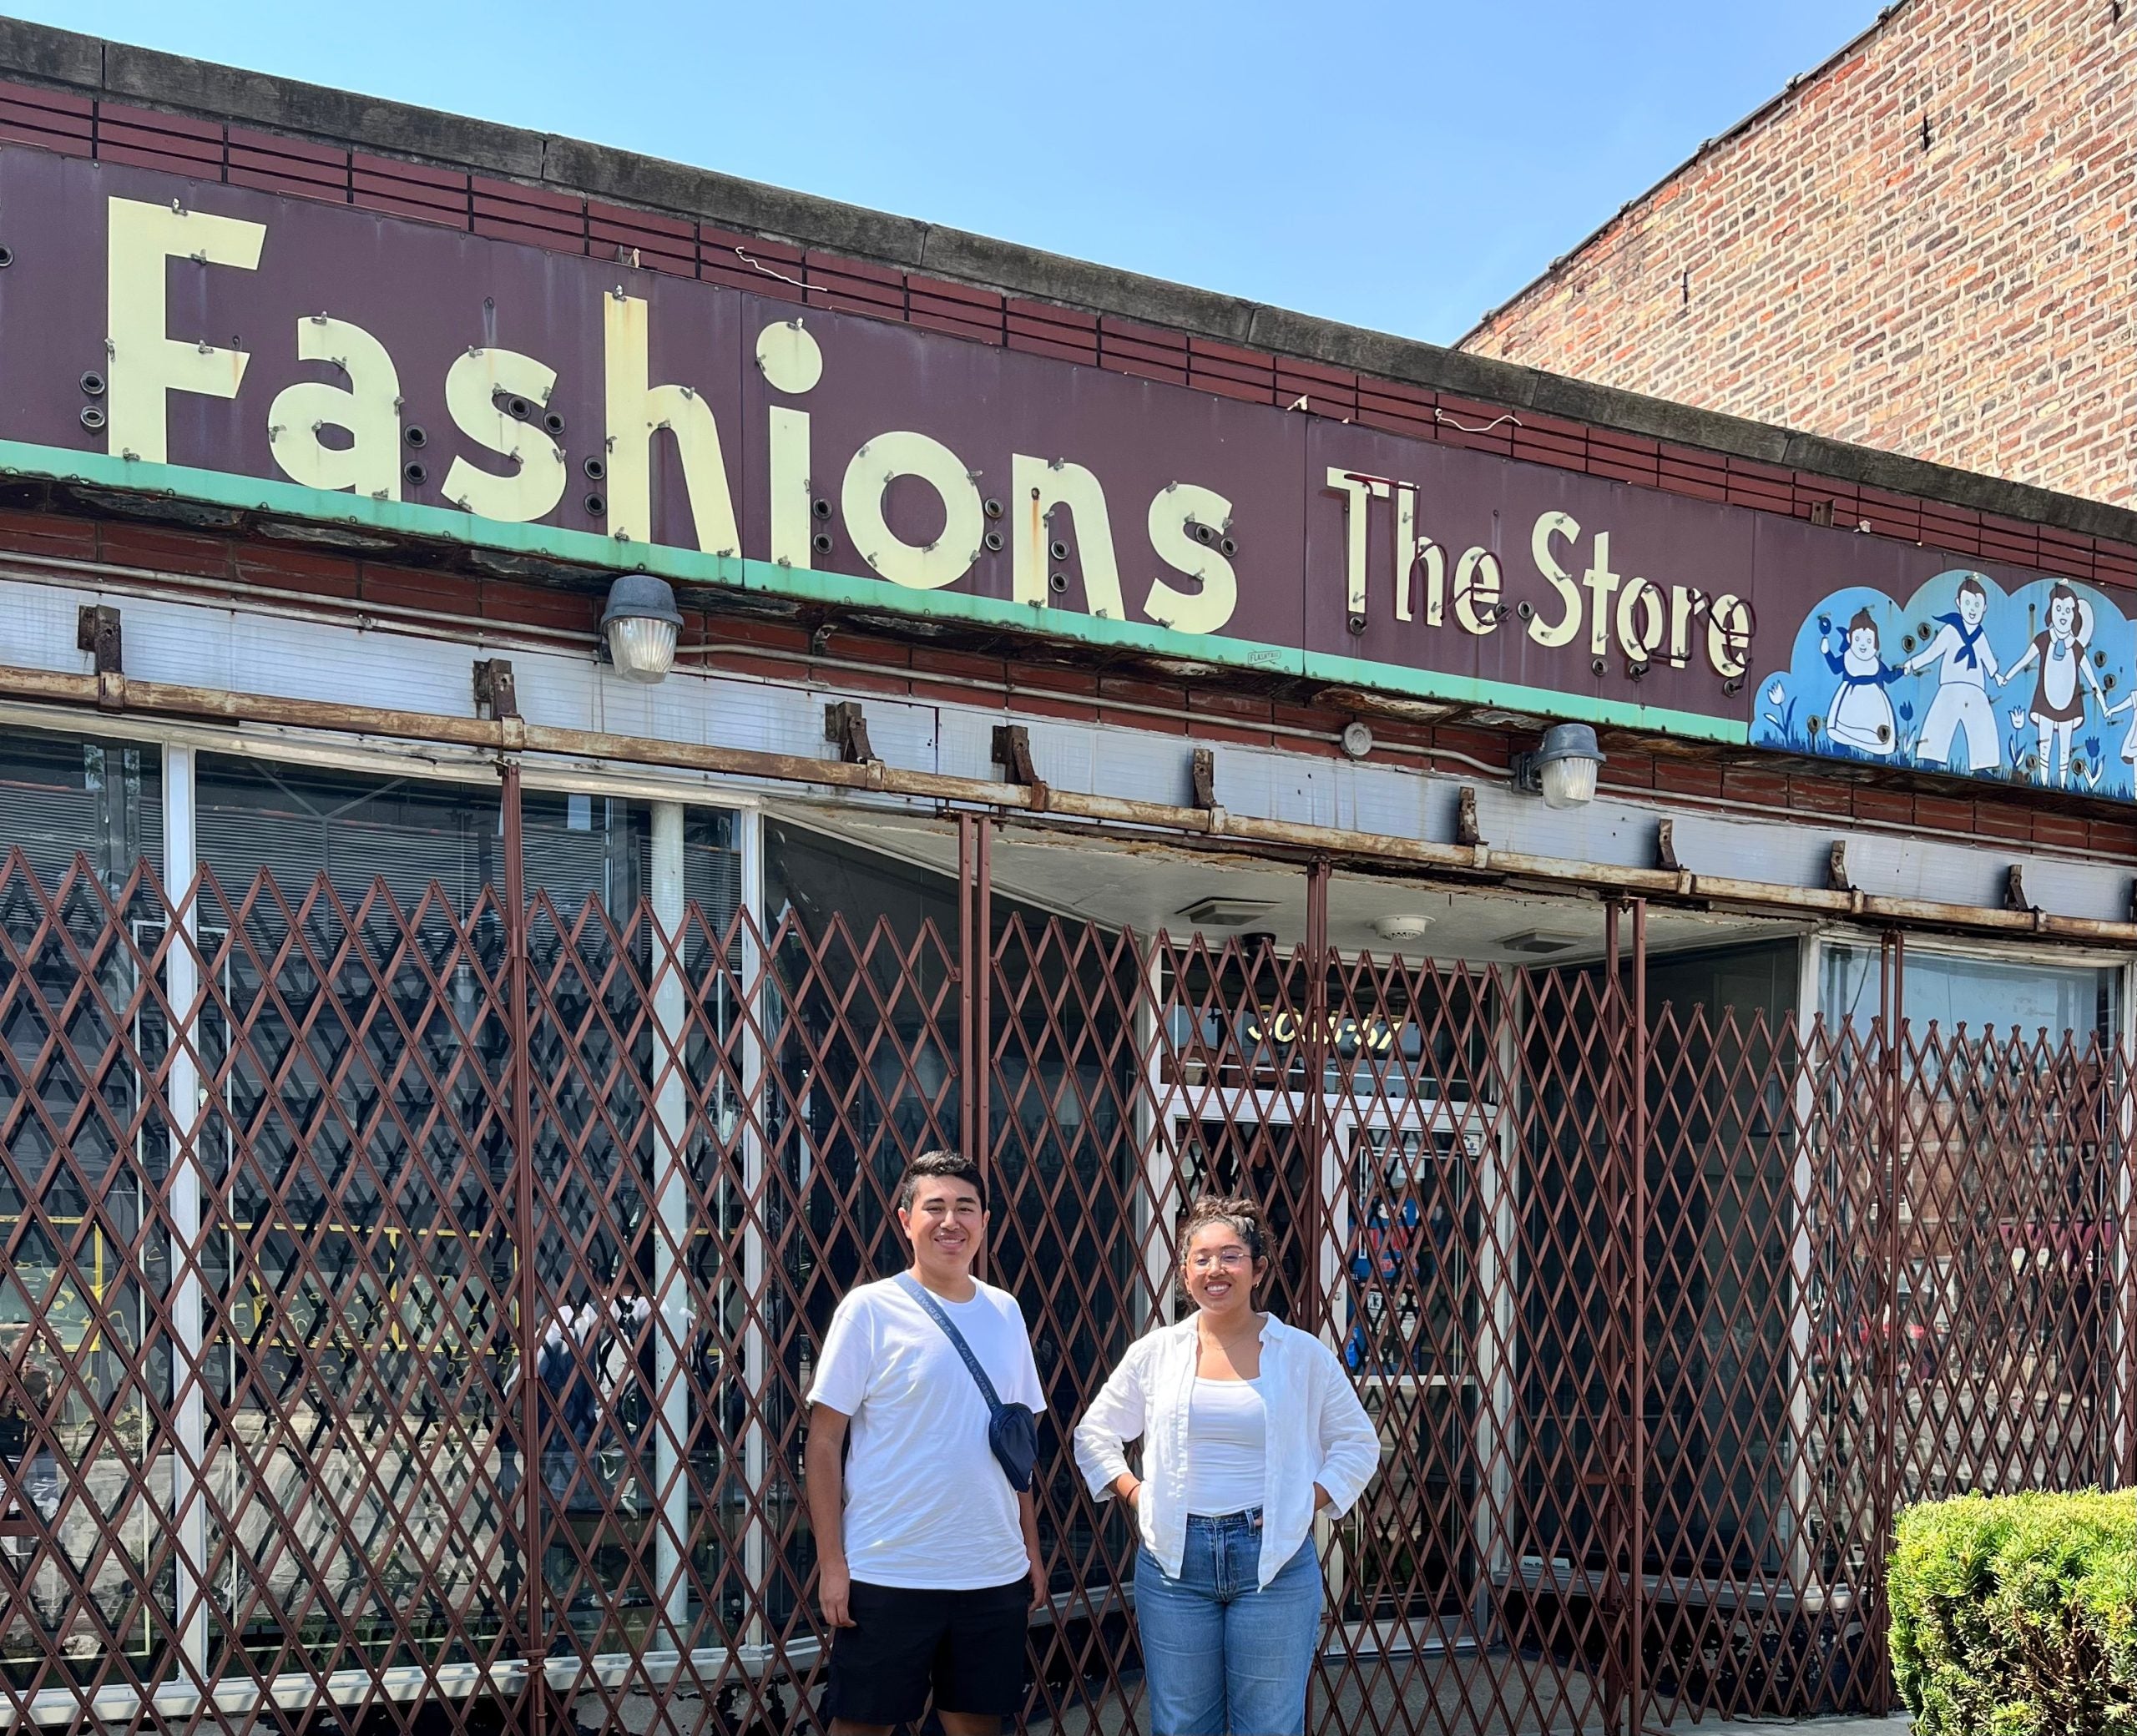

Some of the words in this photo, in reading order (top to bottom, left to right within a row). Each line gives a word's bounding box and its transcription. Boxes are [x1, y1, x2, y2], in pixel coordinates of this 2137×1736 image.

[109, 196, 1237, 634] Fashions
[1326, 466, 1503, 635] The
[1527, 510, 1752, 678] Store
[958, 1340, 998, 1411] Volkswagen
